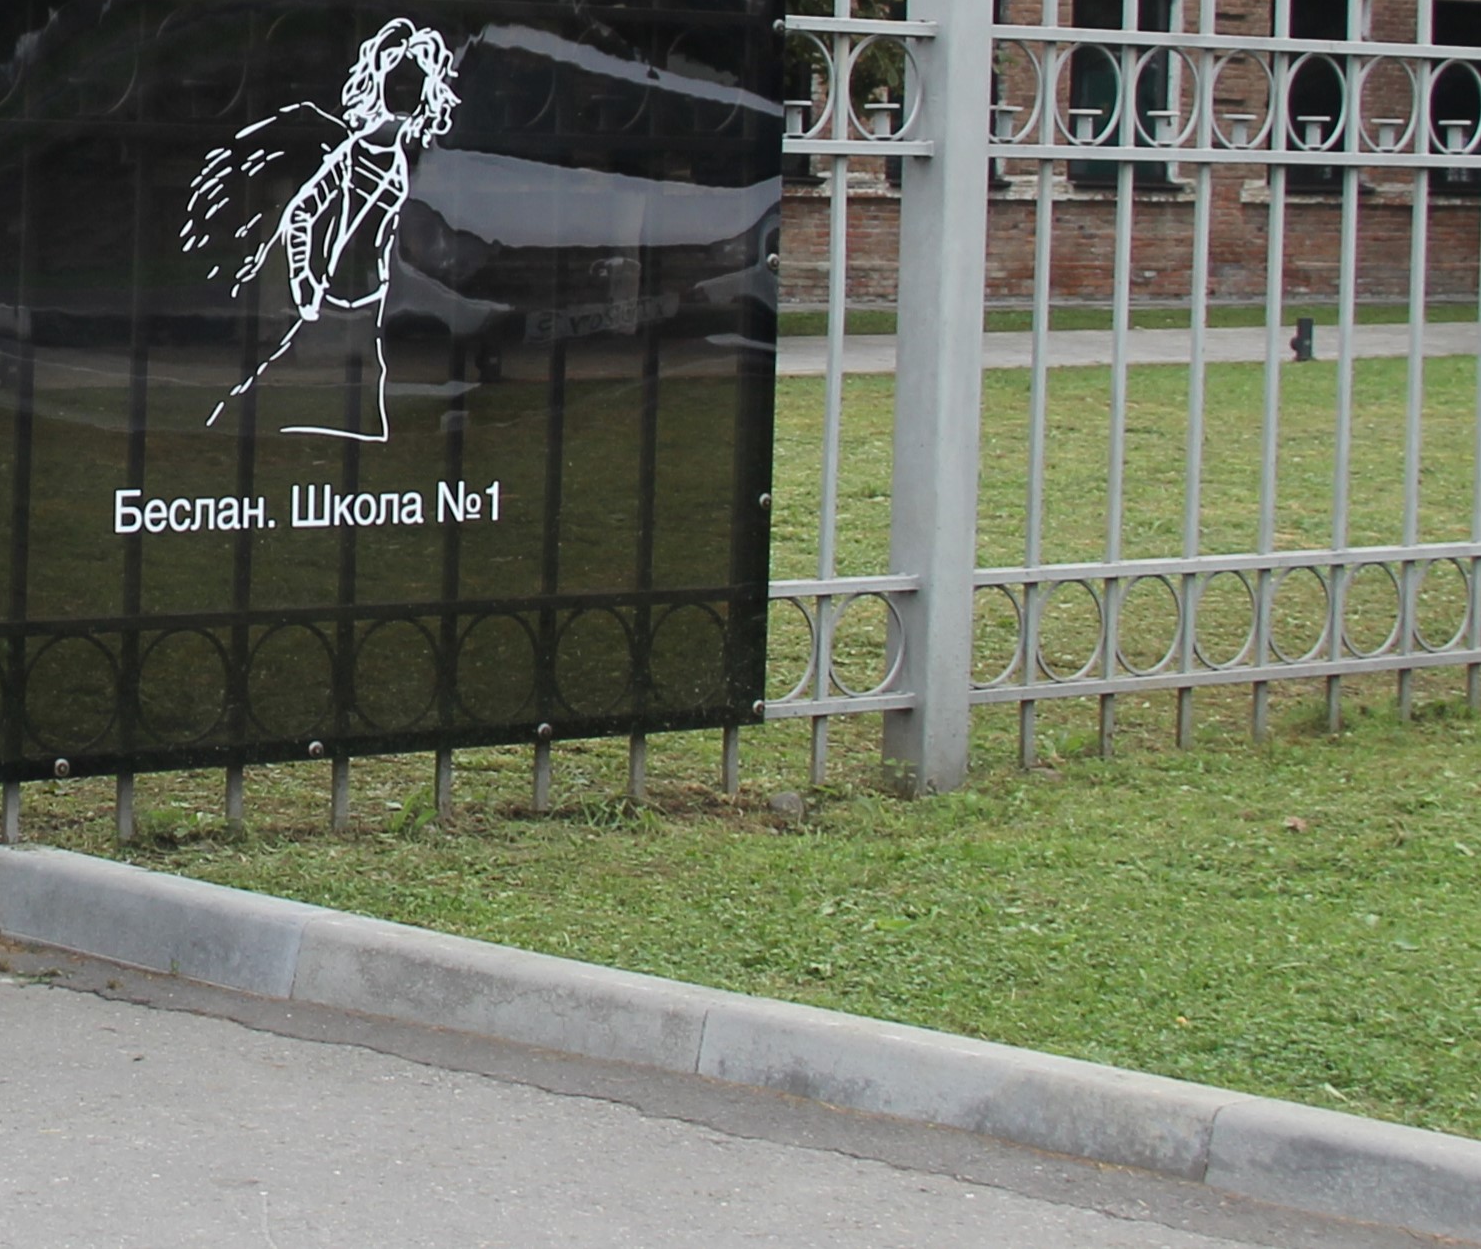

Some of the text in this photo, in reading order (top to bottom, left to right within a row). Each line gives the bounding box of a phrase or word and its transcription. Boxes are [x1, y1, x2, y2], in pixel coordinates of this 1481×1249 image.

[114, 480, 501, 533] Беслан. Школа №1
